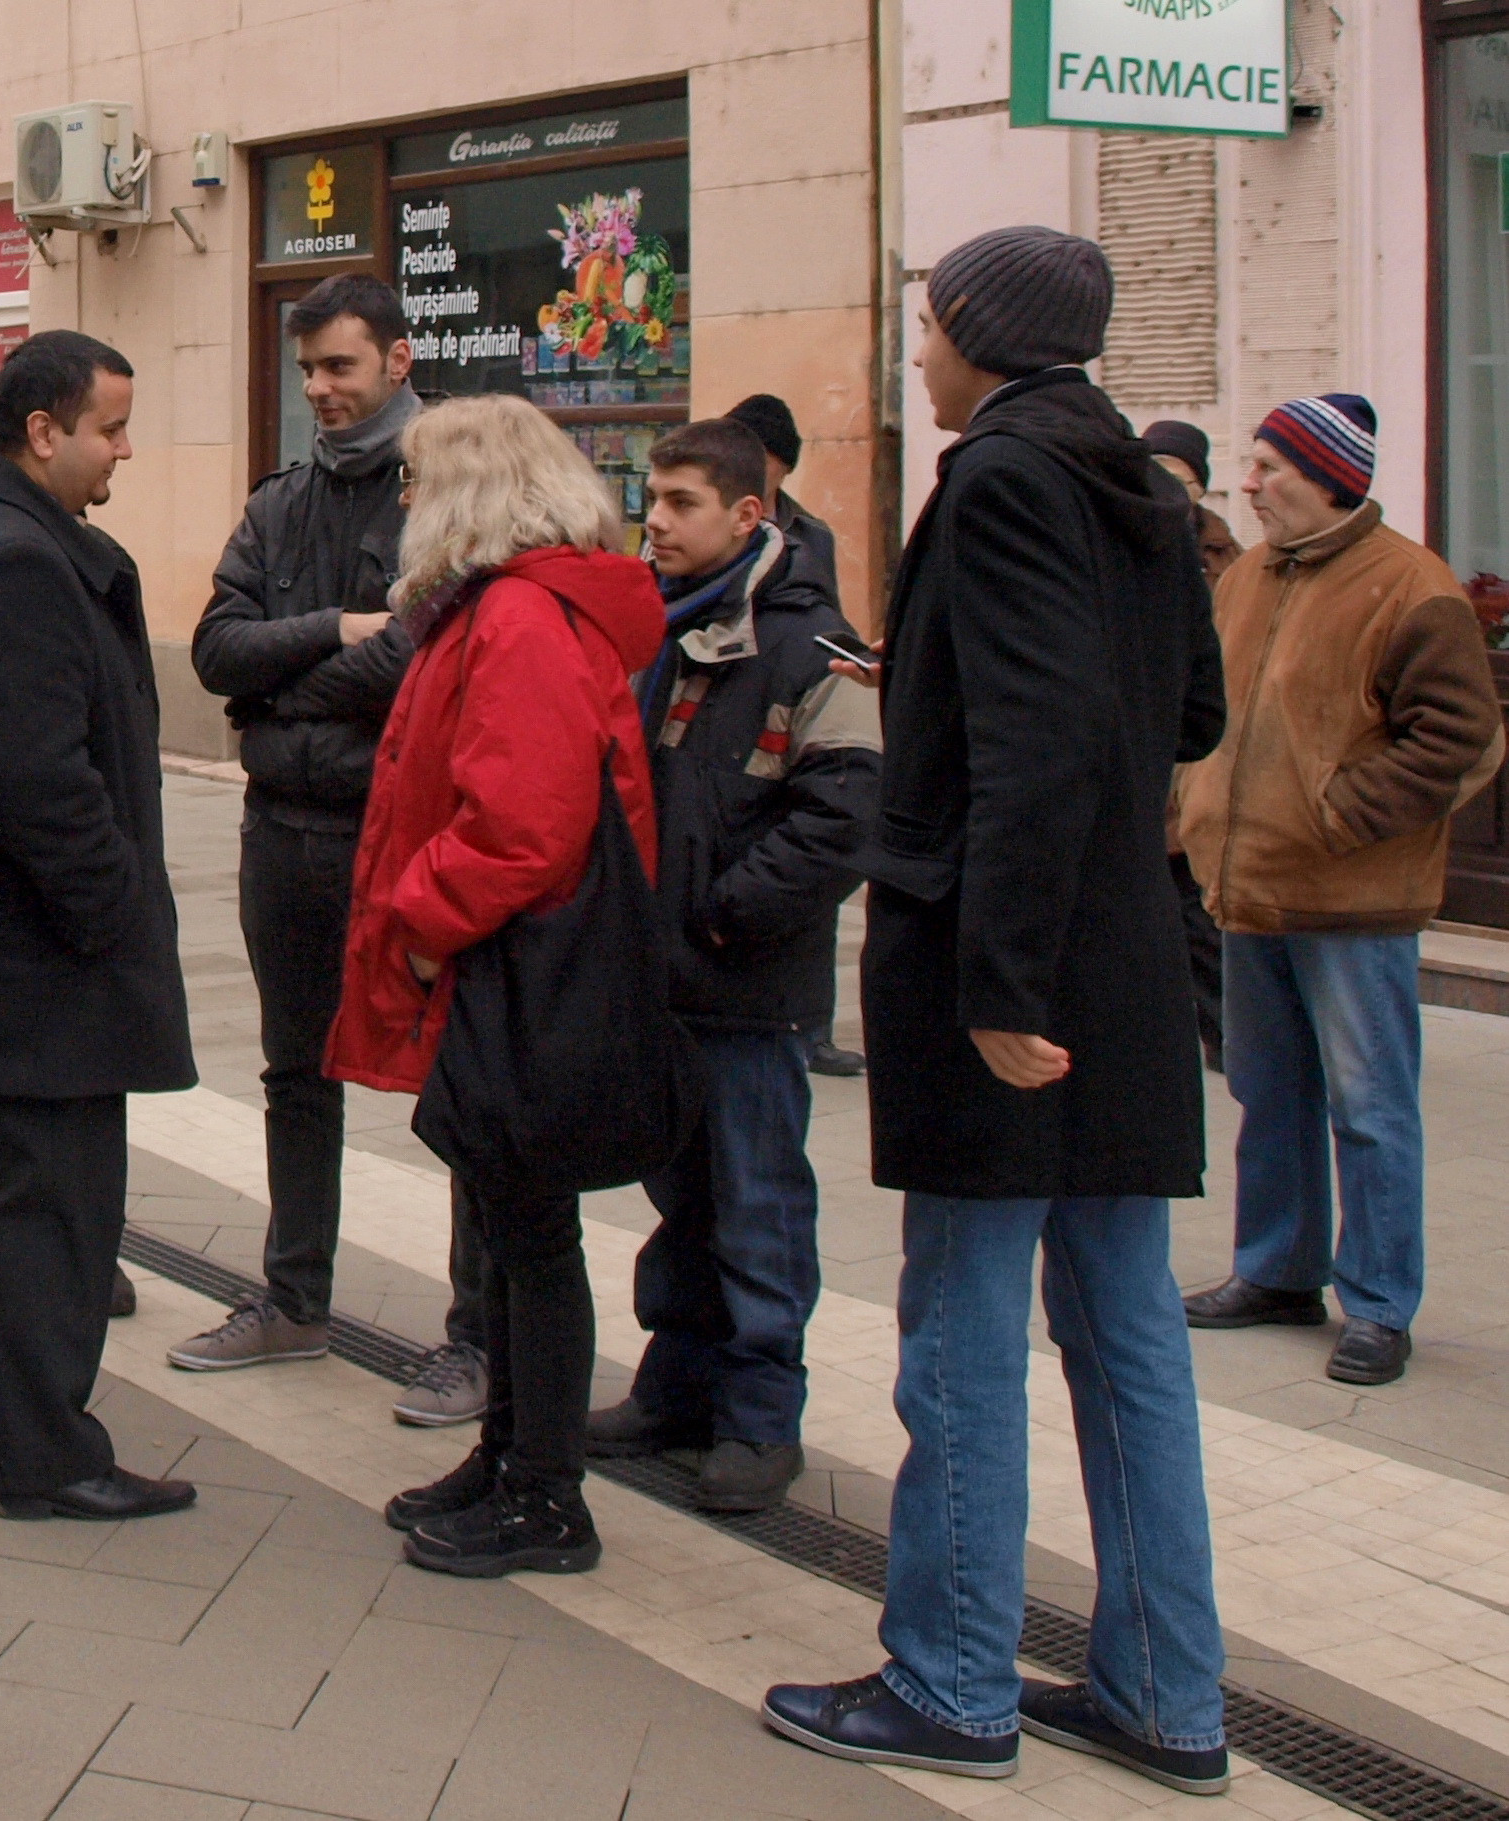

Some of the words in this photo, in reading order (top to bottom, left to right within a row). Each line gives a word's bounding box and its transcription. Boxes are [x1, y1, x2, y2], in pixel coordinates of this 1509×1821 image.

[1058, 52, 1280, 104] FARMACIE
[284, 233, 356, 254] AGROSEM
[401, 242, 457, 276] Pesticide
[441, 328, 458, 360] de
